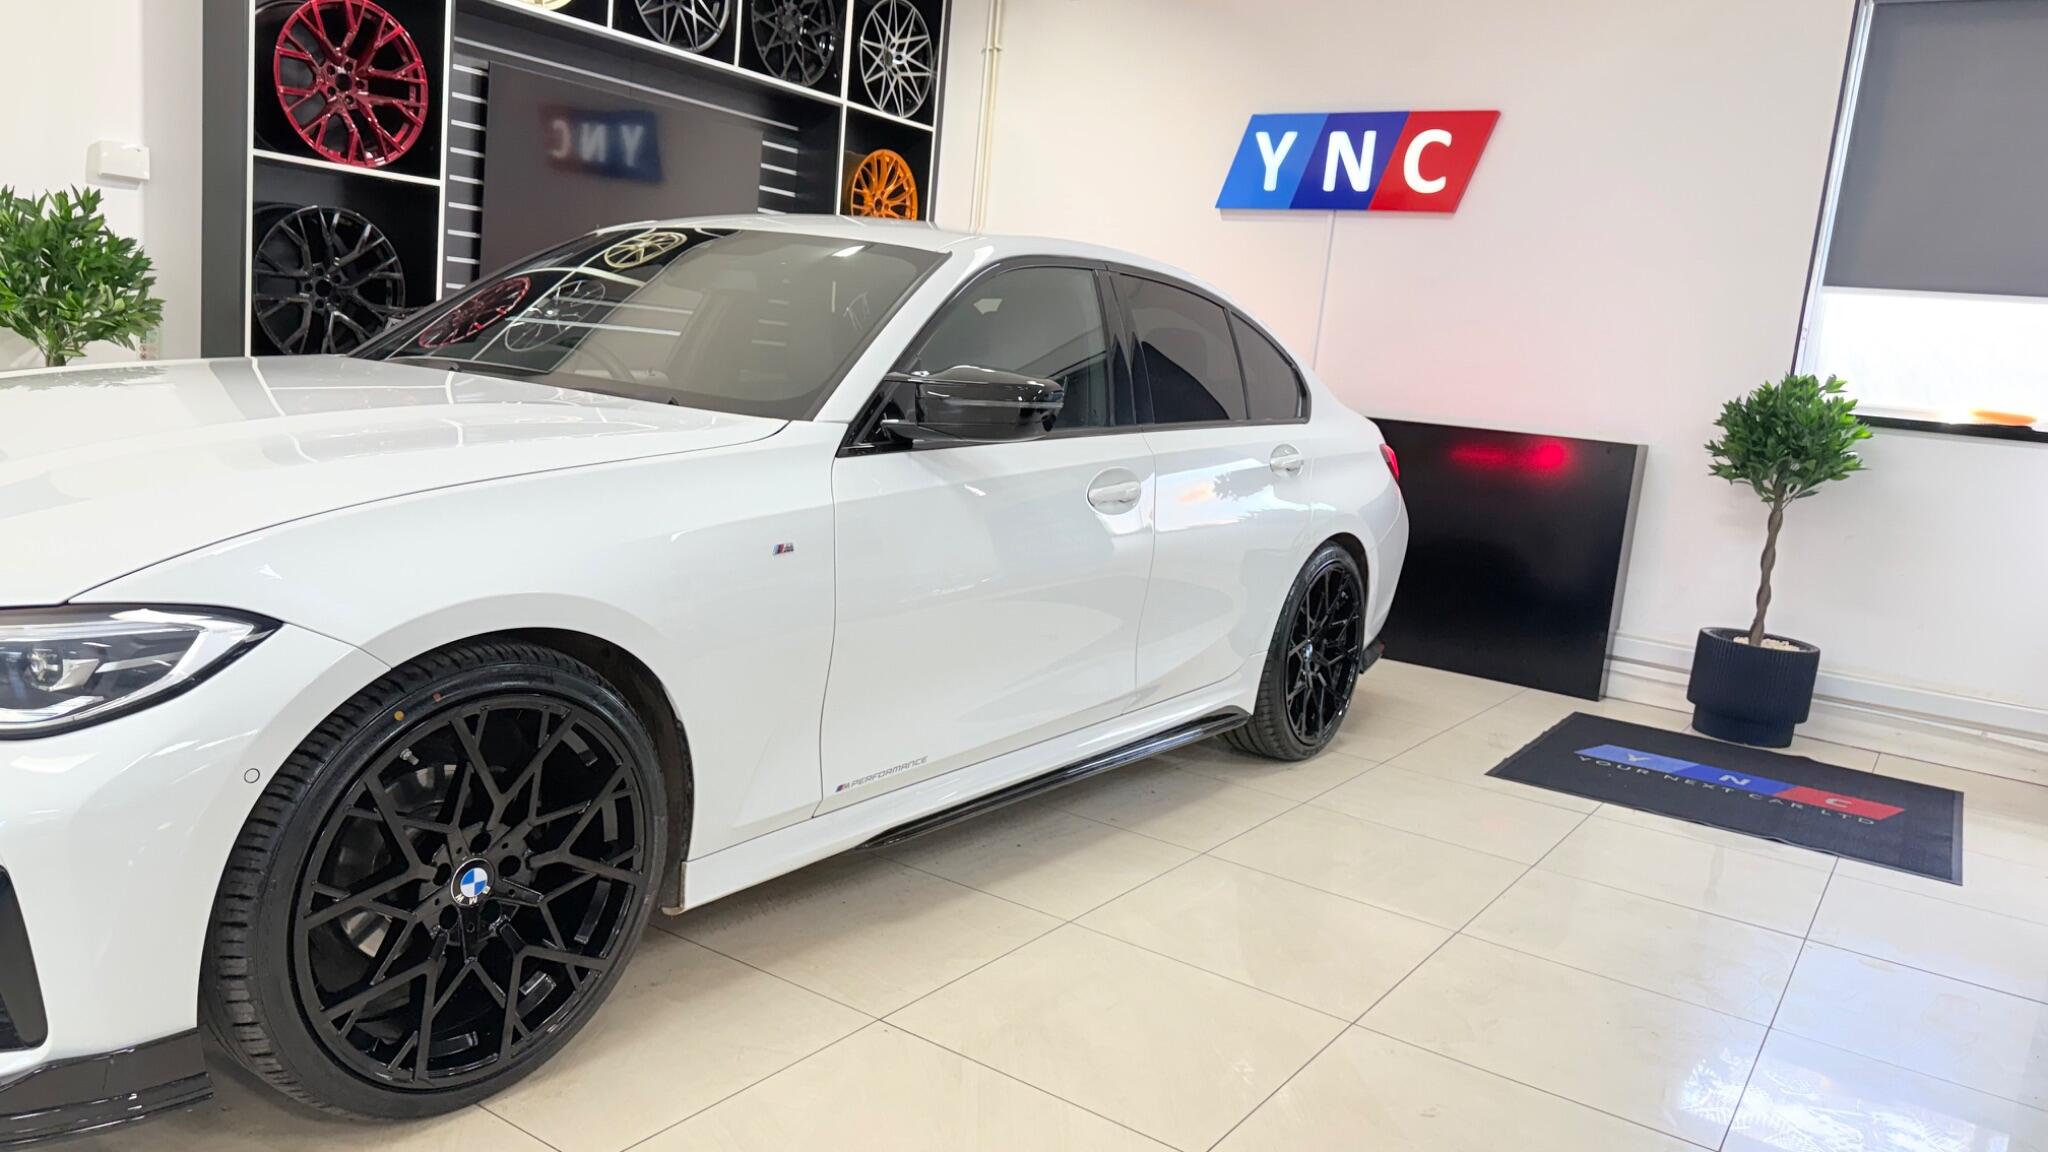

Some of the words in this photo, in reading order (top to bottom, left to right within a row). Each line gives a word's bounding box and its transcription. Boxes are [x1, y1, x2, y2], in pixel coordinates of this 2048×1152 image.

[1255, 129, 1452, 194] YNC
[851, 755, 928, 787] PERFORMANCE
[1579, 755, 1649, 775] YOUR
[1664, 774, 1735, 793] NEXT
[1748, 793, 1804, 809] CAR
[1821, 809, 1874, 825] LTD
